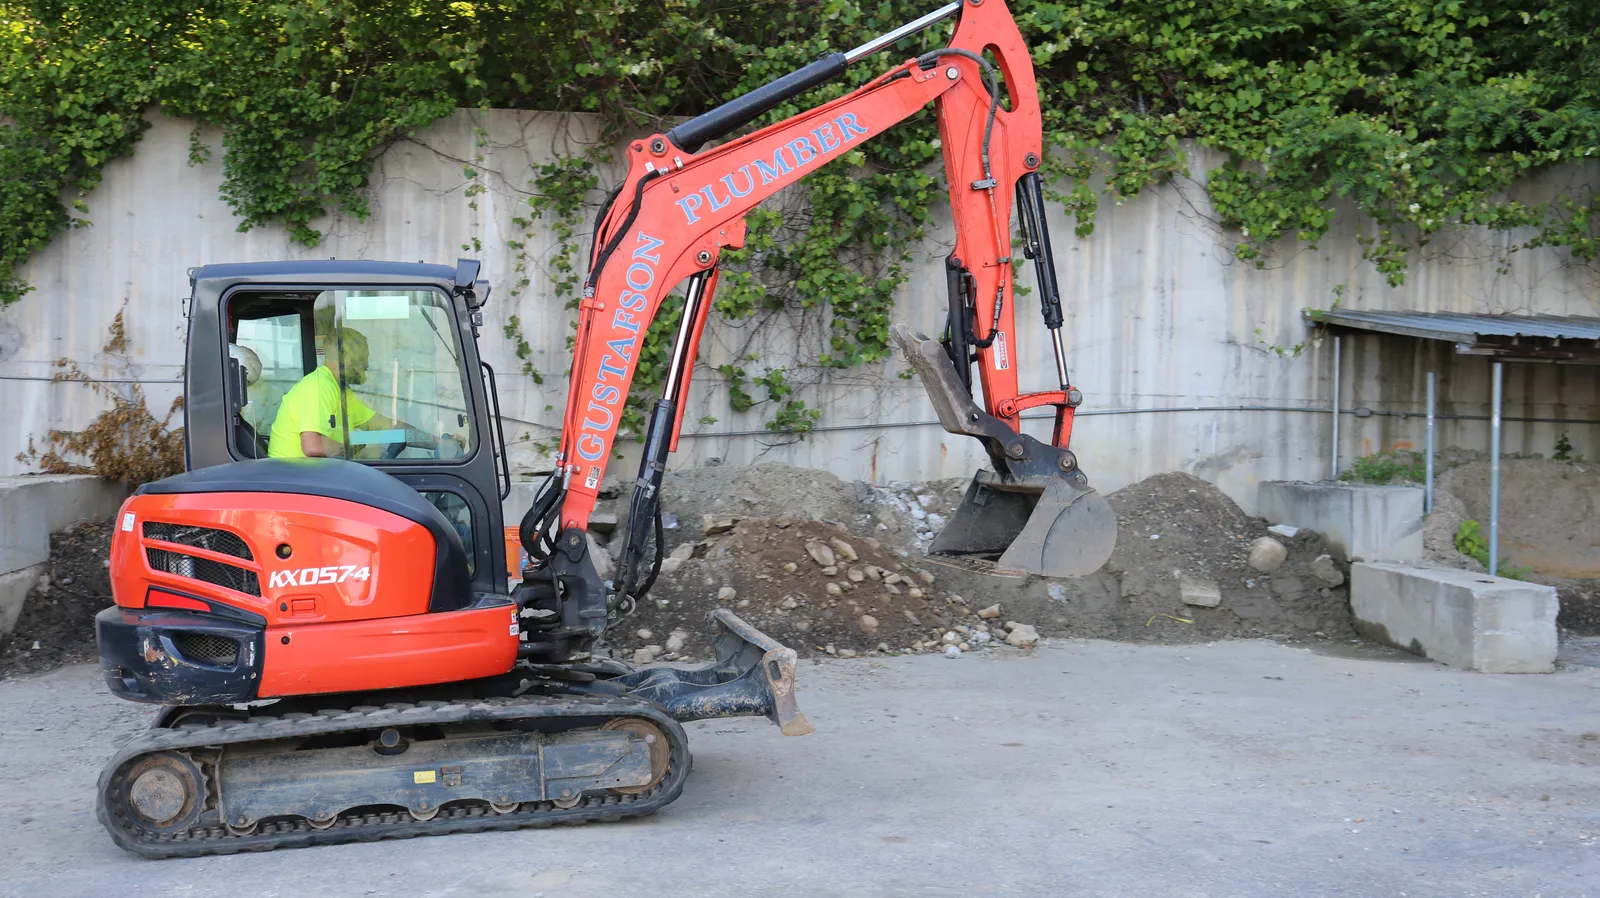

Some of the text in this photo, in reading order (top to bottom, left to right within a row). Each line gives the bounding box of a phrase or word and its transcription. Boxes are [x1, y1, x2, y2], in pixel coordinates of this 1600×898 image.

[577, 112, 868, 461] GUSTAFSON PLUMBER
[268, 565, 370, 588] KX057-4
